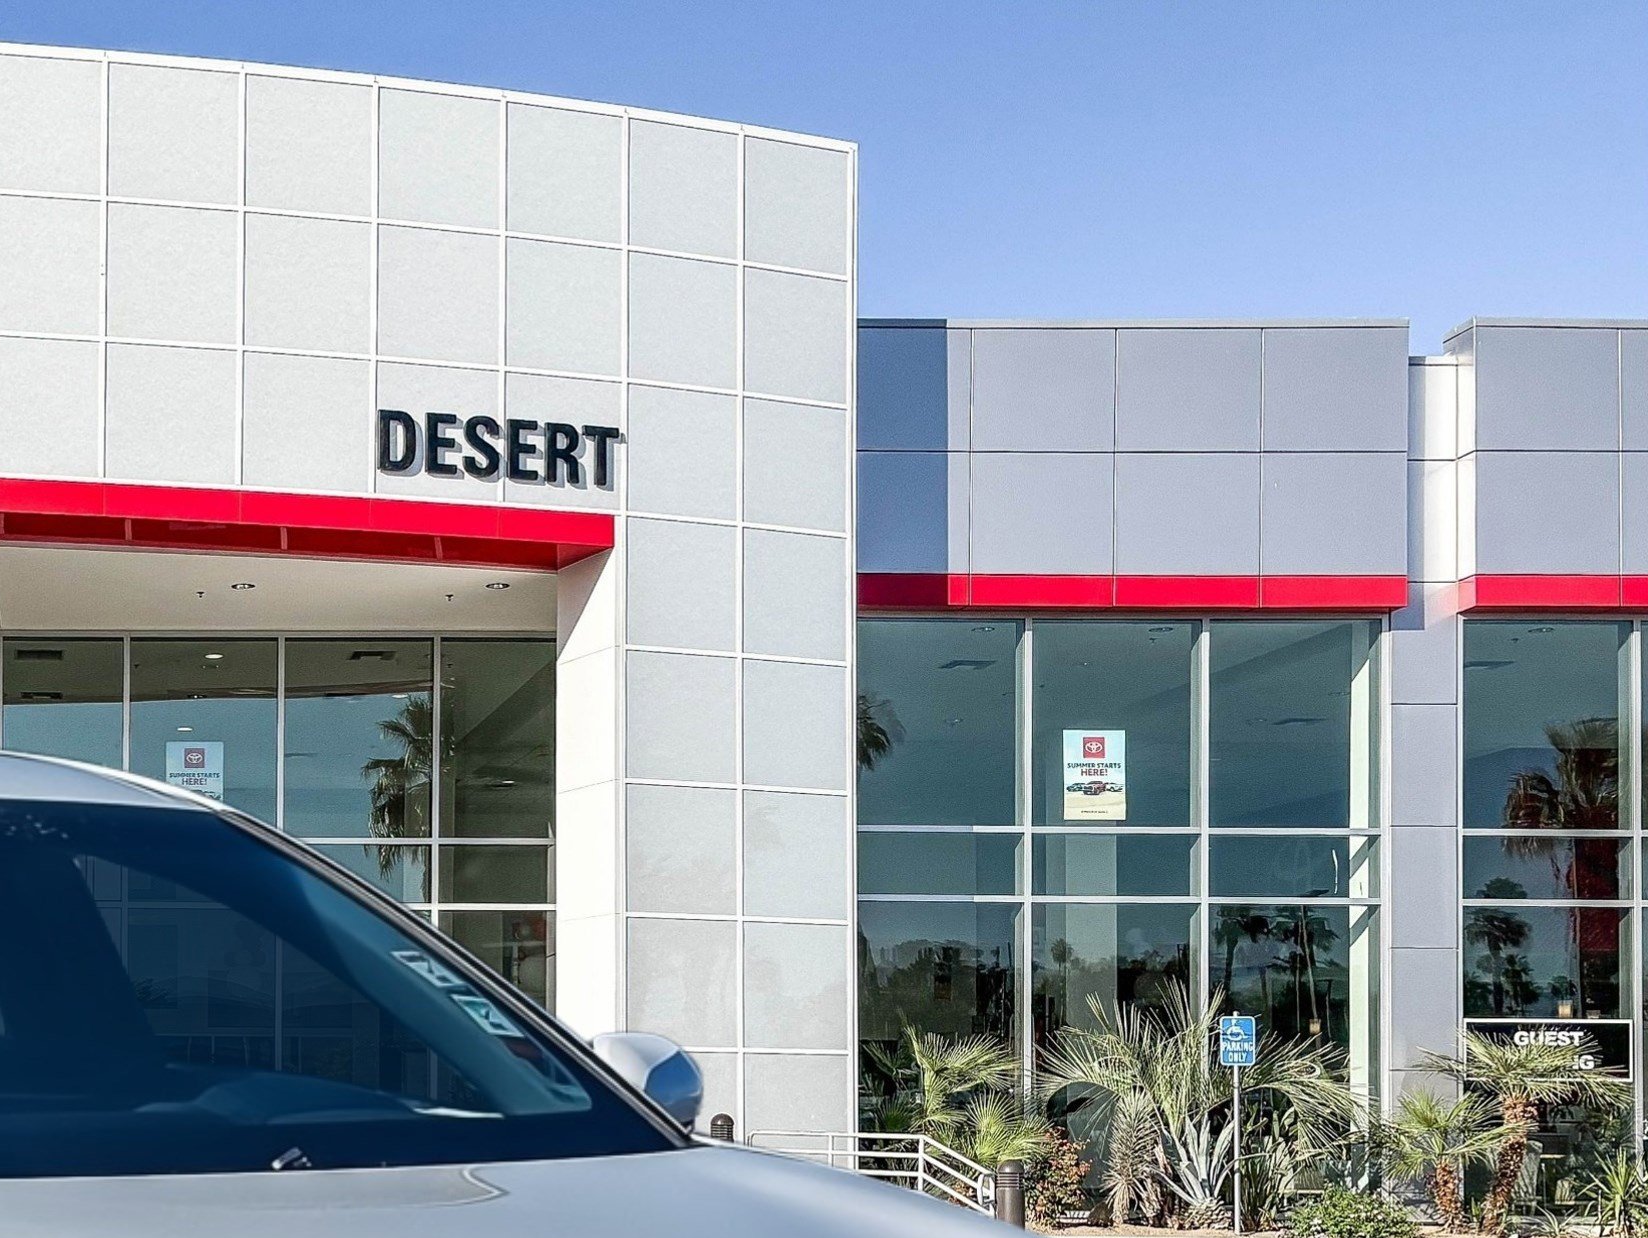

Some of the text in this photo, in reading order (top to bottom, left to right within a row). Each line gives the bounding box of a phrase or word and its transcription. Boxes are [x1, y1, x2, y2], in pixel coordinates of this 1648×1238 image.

[377, 409, 620, 487] DESERT
[1080, 768, 1108, 777] HERE!
[181, 778, 207, 786] HERE!
[1513, 1030, 1584, 1047] GUEST
[1221, 1041, 1254, 1052] PARKING
[1227, 1052, 1248, 1062] ONLY
